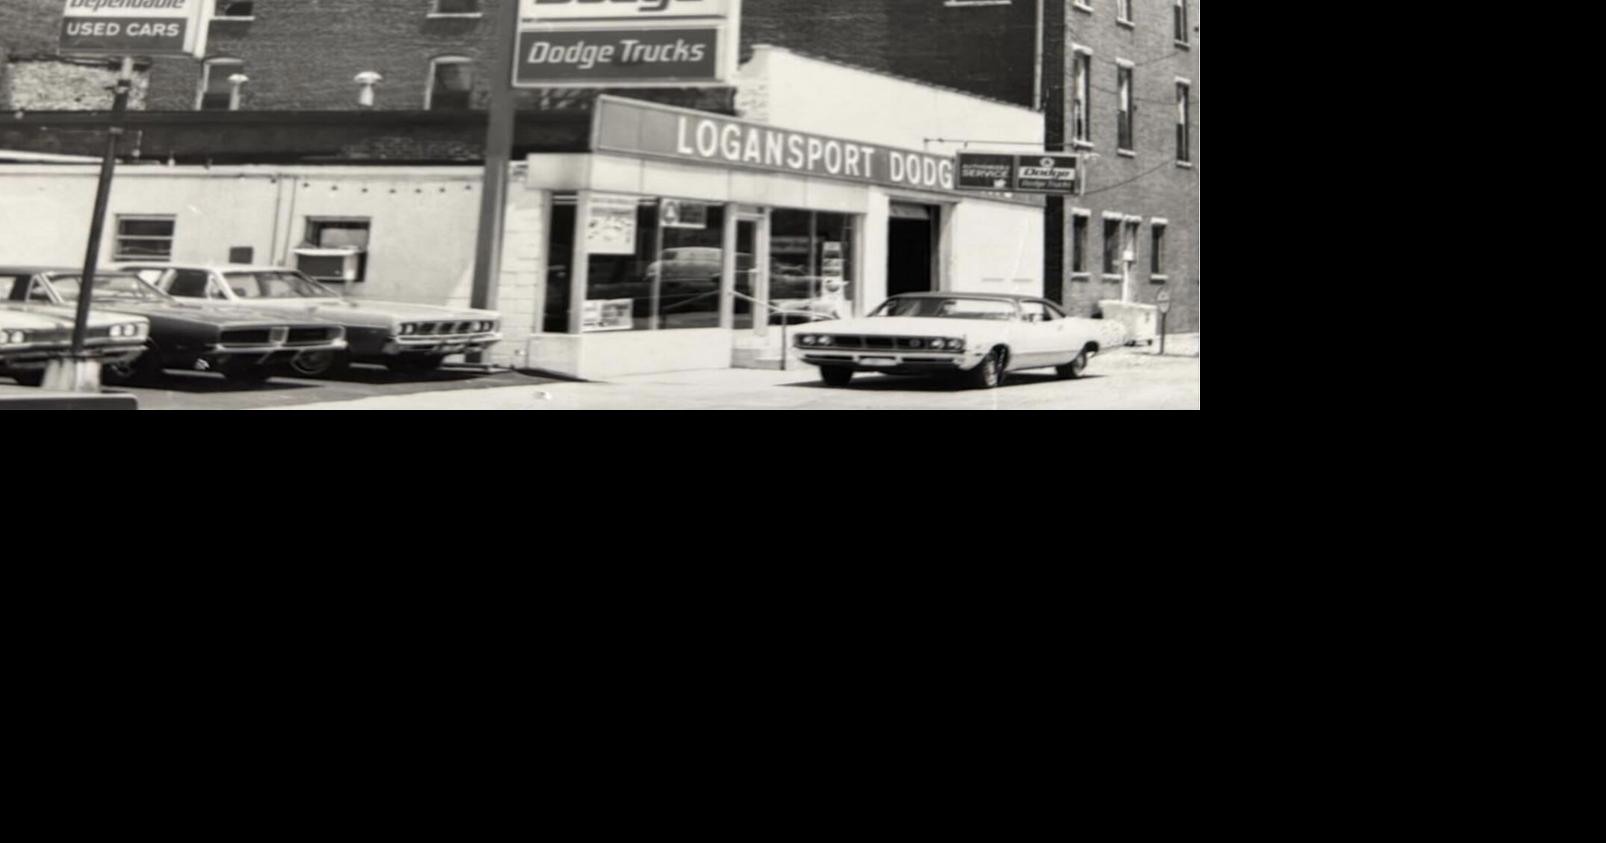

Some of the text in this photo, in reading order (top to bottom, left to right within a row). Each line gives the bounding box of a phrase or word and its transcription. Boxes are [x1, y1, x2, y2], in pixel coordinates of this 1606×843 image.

[66, 22, 180, 37] USED CARS
[527, 38, 706, 69] Dodge Trucks
[677, 117, 954, 189] LOGANSPORT DODG
[962, 169, 1009, 178] SERVICE
[1023, 168, 1071, 180] Dodge
